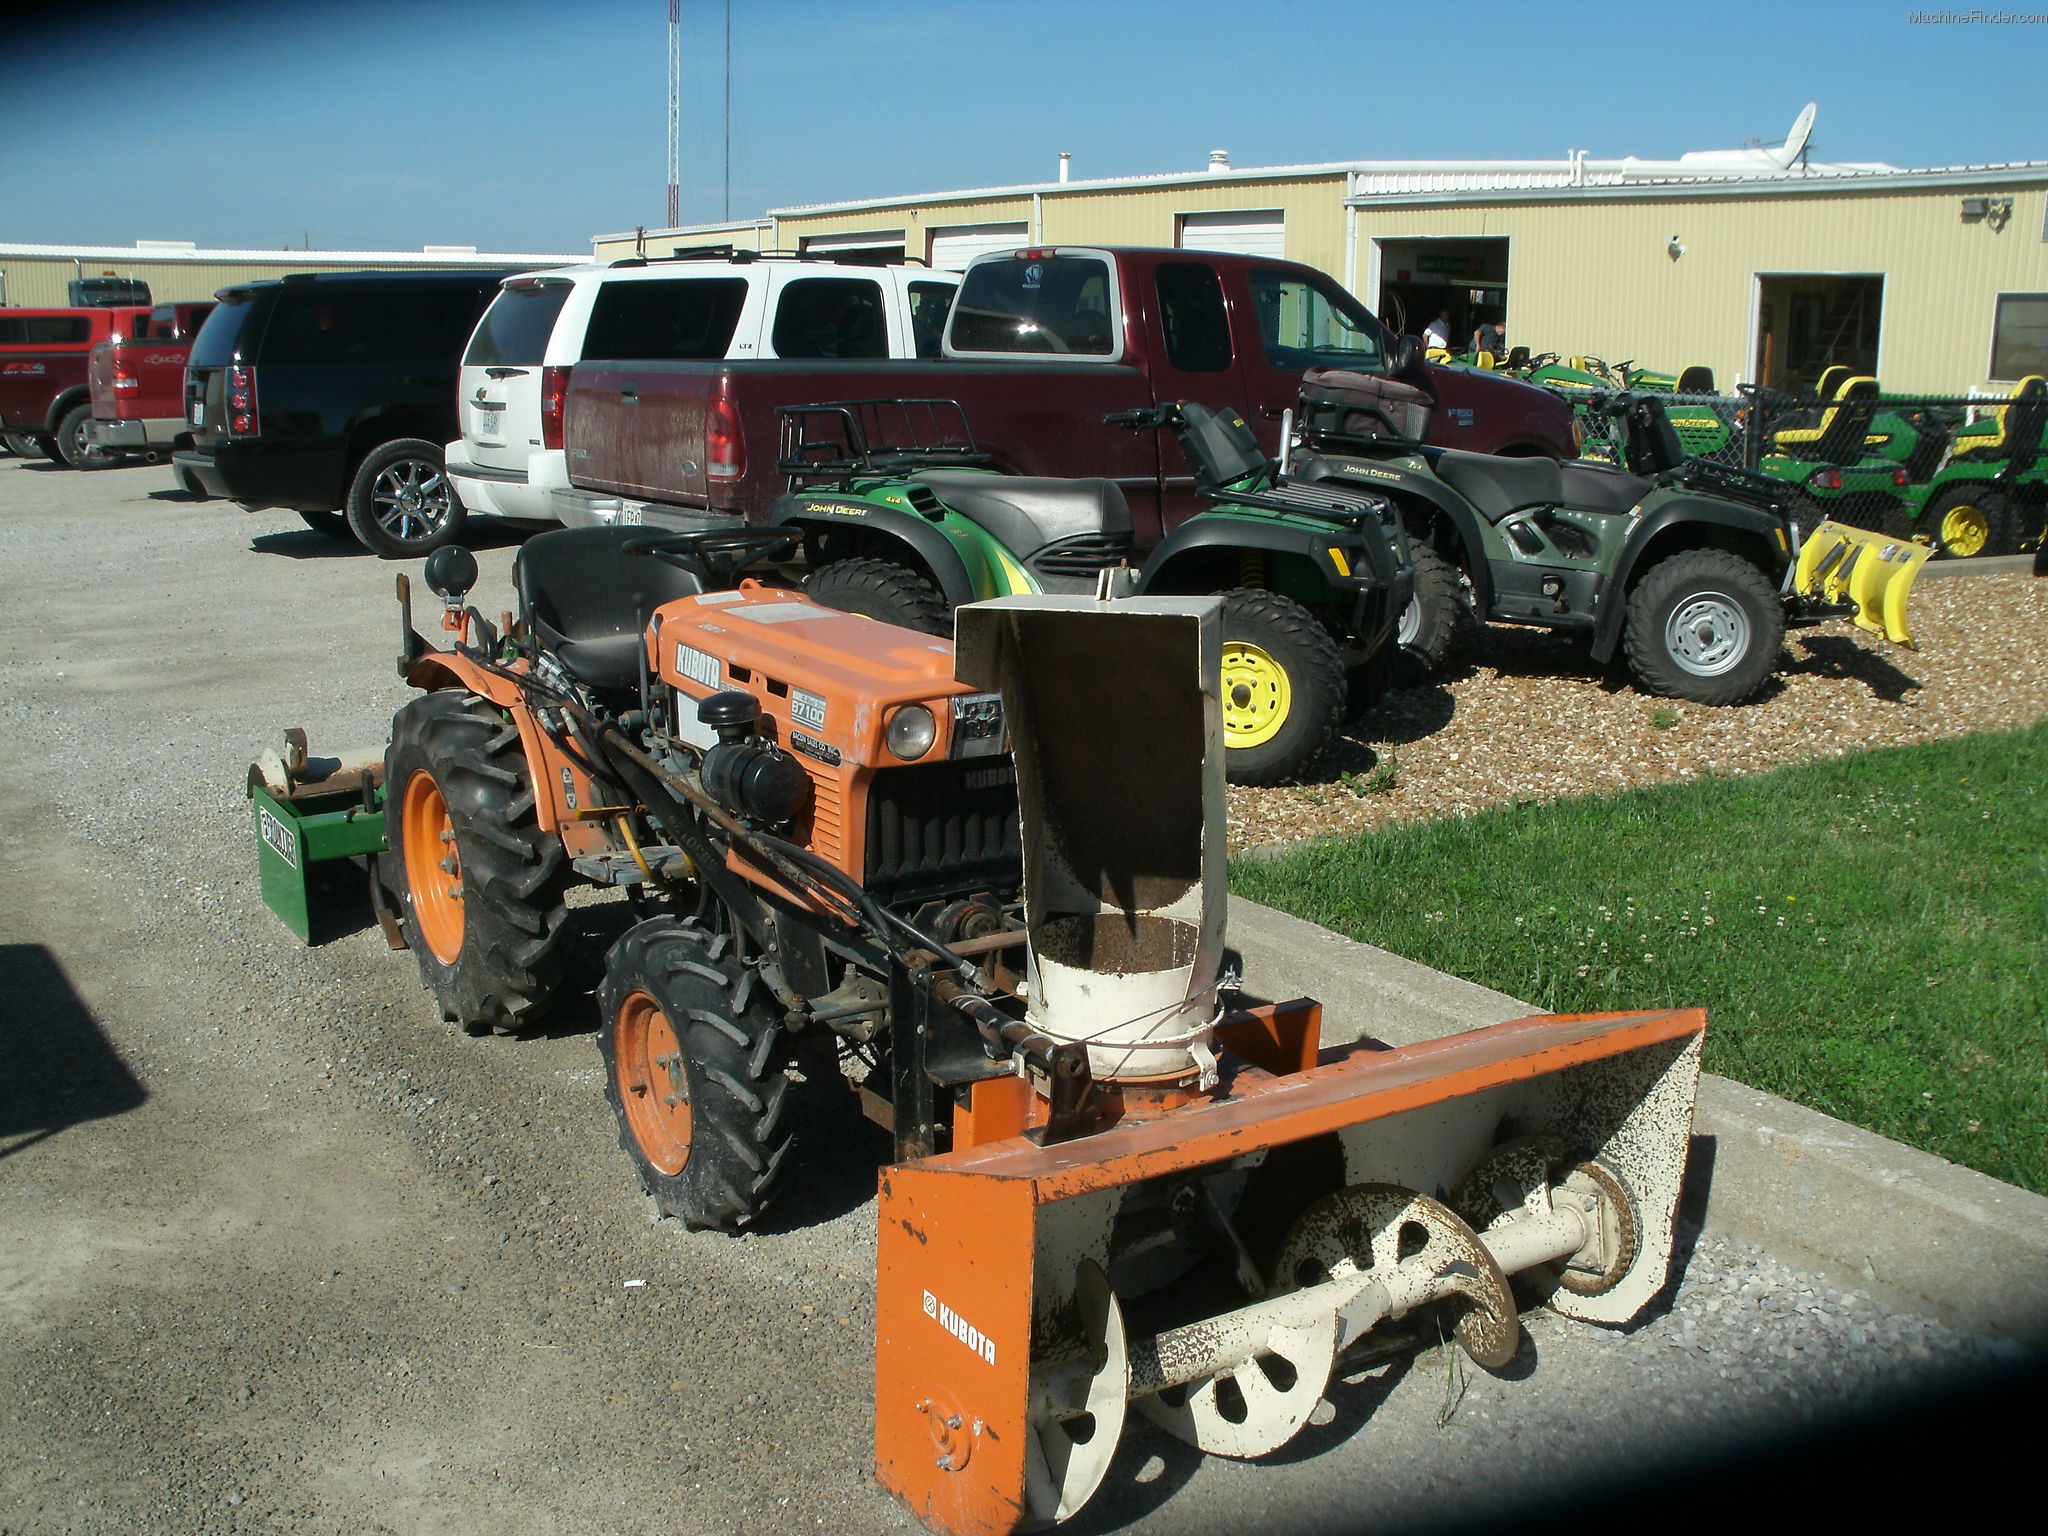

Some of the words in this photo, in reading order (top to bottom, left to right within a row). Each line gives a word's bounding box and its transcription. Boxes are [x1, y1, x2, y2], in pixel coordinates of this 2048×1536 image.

[1343, 465, 1369, 476] JOHN
[1371, 470, 1401, 481] DEERE
[807, 503, 834, 515] JOHN
[676, 643, 720, 690] KUBOTA
[965, 767, 1015, 790] KUBOT
[939, 1302, 996, 1367] KUBOTA
